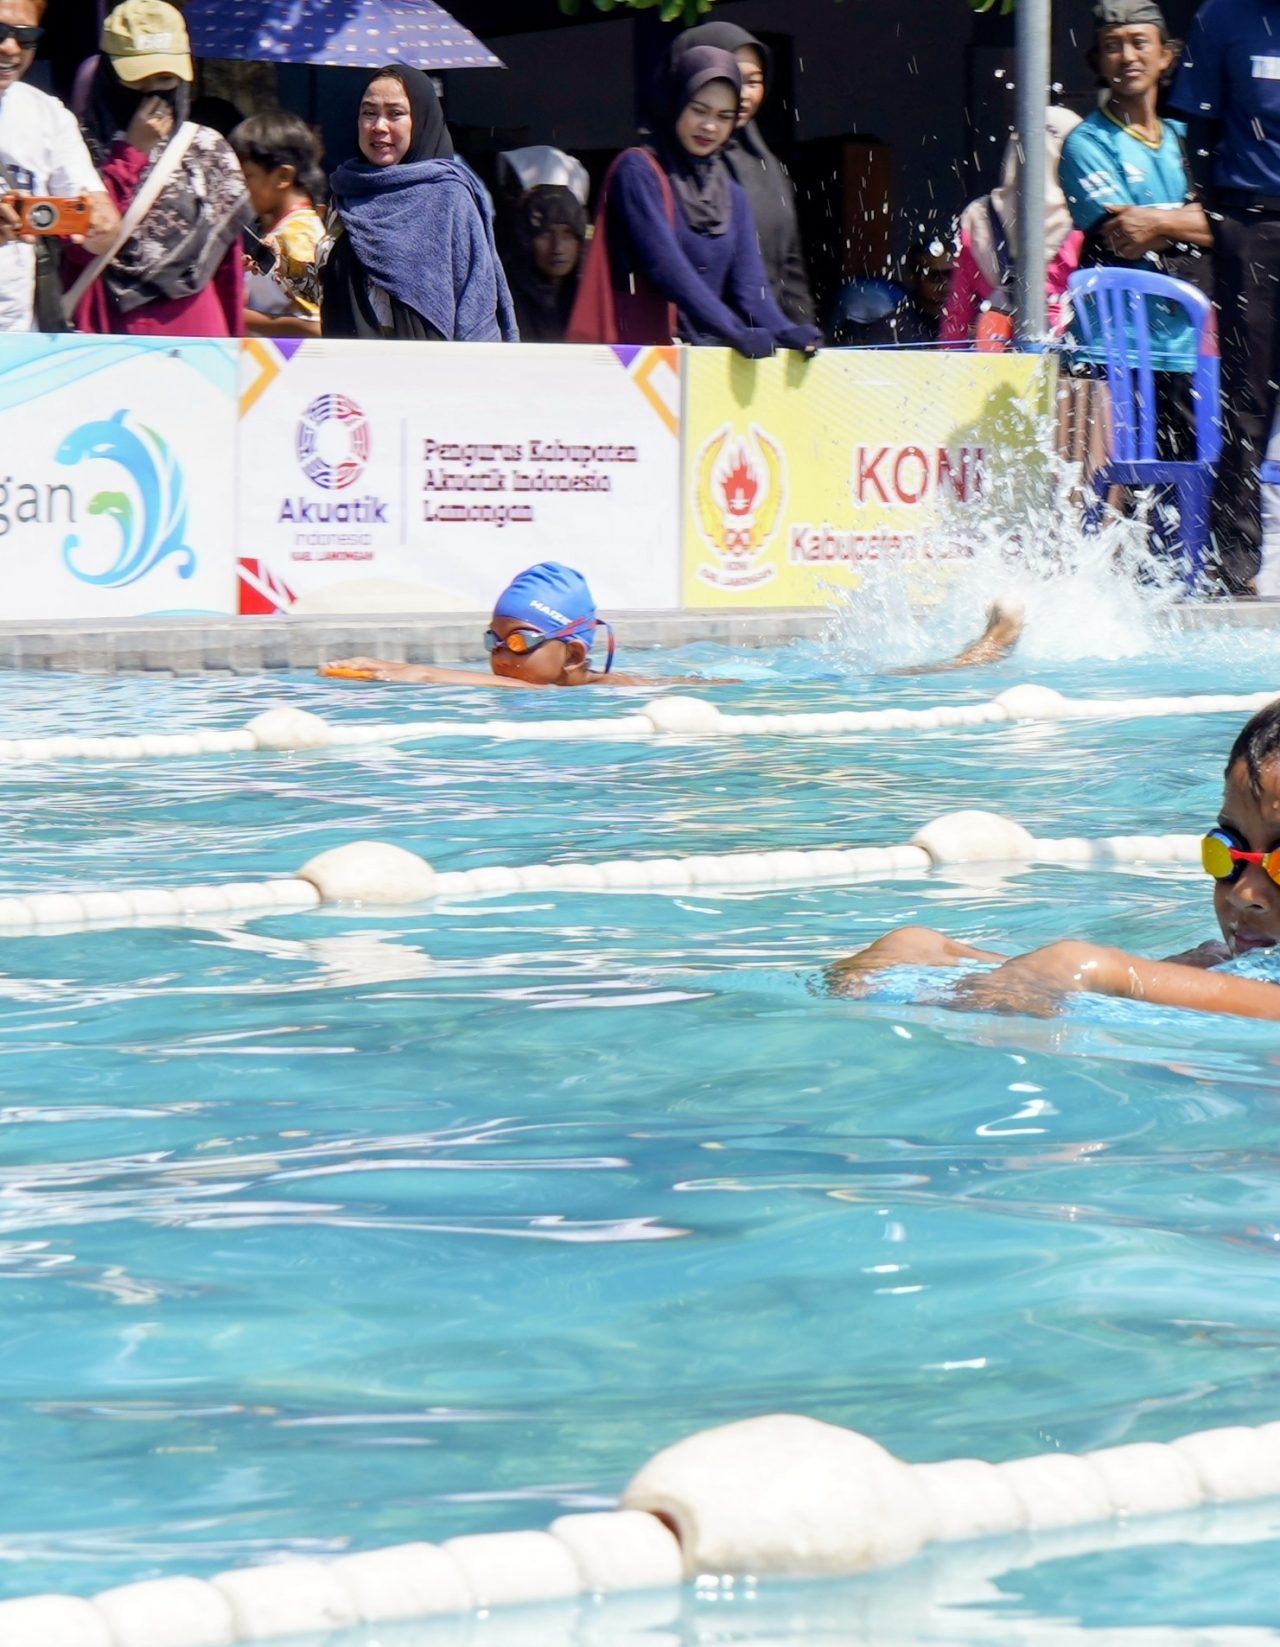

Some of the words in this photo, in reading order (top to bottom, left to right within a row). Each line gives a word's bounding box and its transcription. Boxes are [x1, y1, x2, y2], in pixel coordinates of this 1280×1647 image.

[424, 437, 522, 467] Pengurus
[528, 438, 638, 468] Kabupaten
[424, 468, 506, 491] Akuatik
[512, 469, 611, 492] Indonesia
[856, 446, 984, 504] KONI
[277, 495, 389, 523] Akuatik
[424, 499, 534, 528] Lamongan
